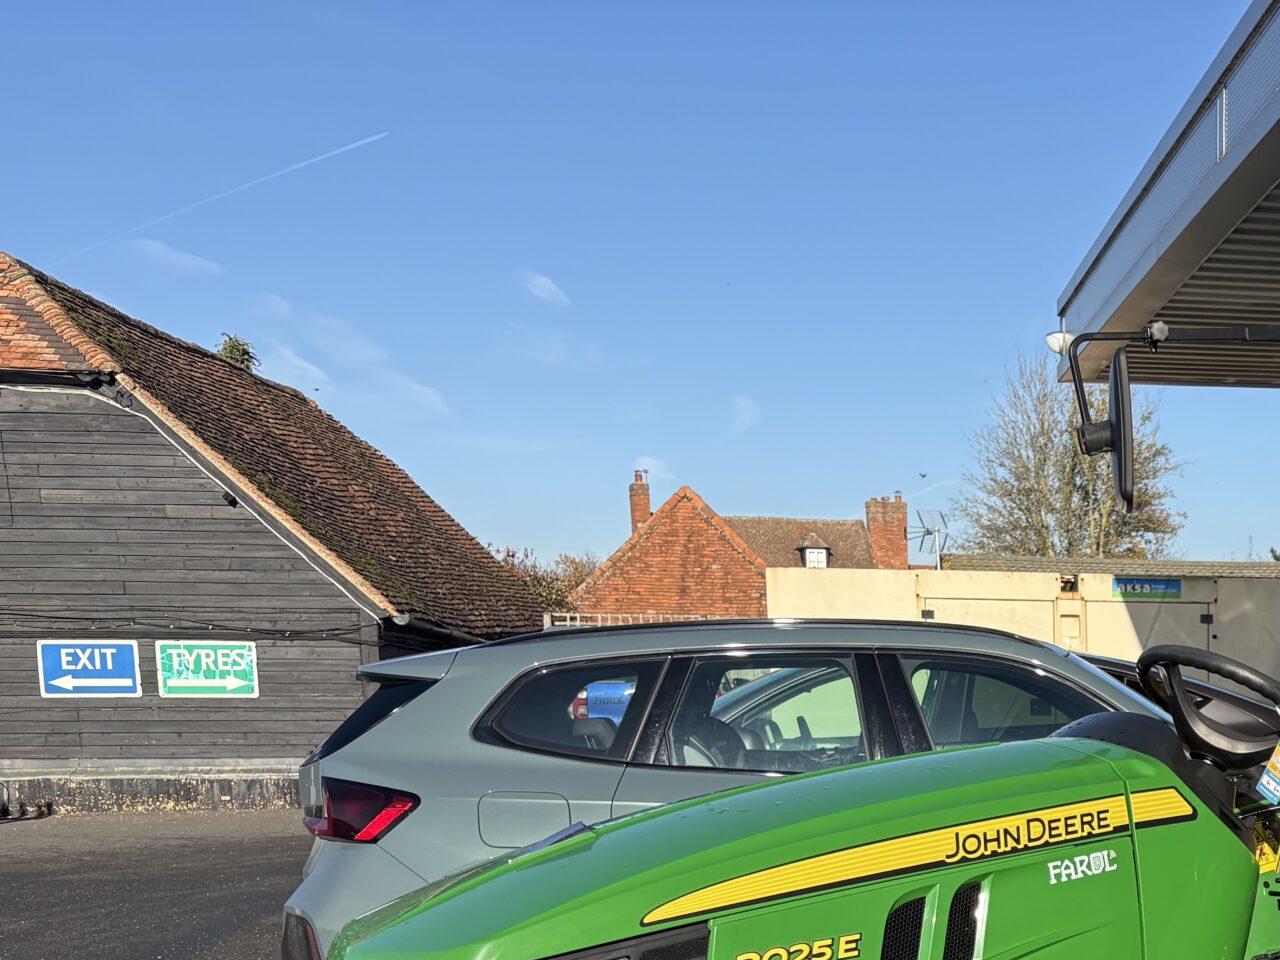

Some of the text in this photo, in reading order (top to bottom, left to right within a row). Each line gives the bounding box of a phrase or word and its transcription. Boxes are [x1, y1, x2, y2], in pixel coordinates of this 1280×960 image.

[60, 648, 117, 670] EXIT
[167, 648, 247, 671] TYRES
[948, 809, 1111, 861] JOHN DEERE
[1048, 848, 1118, 885] FAROL
